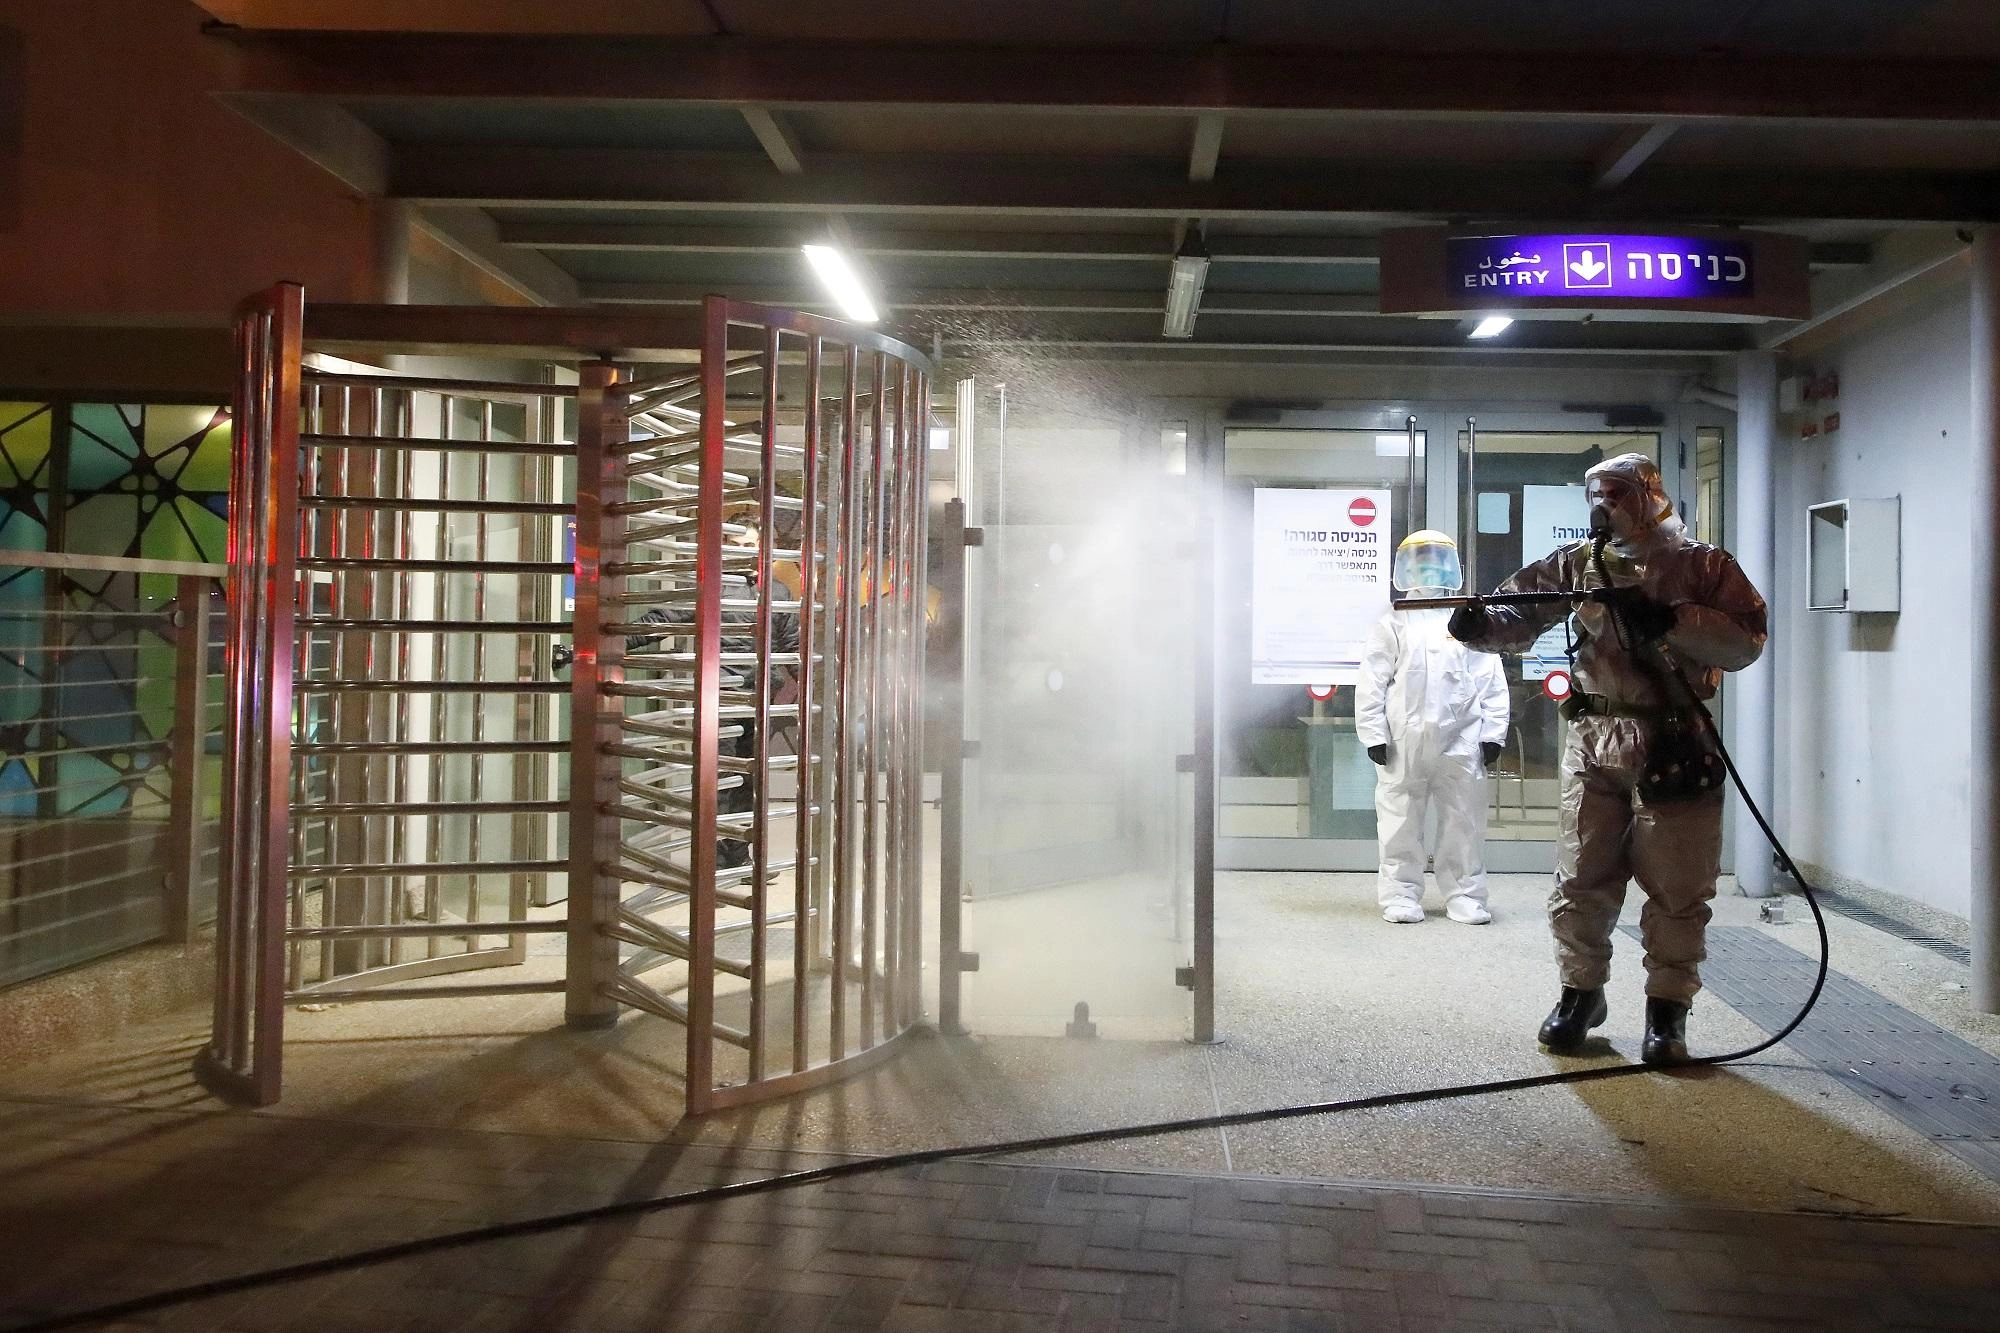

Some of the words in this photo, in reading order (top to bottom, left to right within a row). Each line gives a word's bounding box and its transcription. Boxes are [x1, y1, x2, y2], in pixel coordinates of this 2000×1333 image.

[1478, 251, 1542, 269] دخول
[1626, 252, 1746, 281] כניסה
[1463, 269, 1550, 287] ENTRY
[1284, 529, 1327, 542] סגורה!
[1331, 531, 1377, 543] הכניסה
[1335, 561, 1377, 570] תתאפשר
